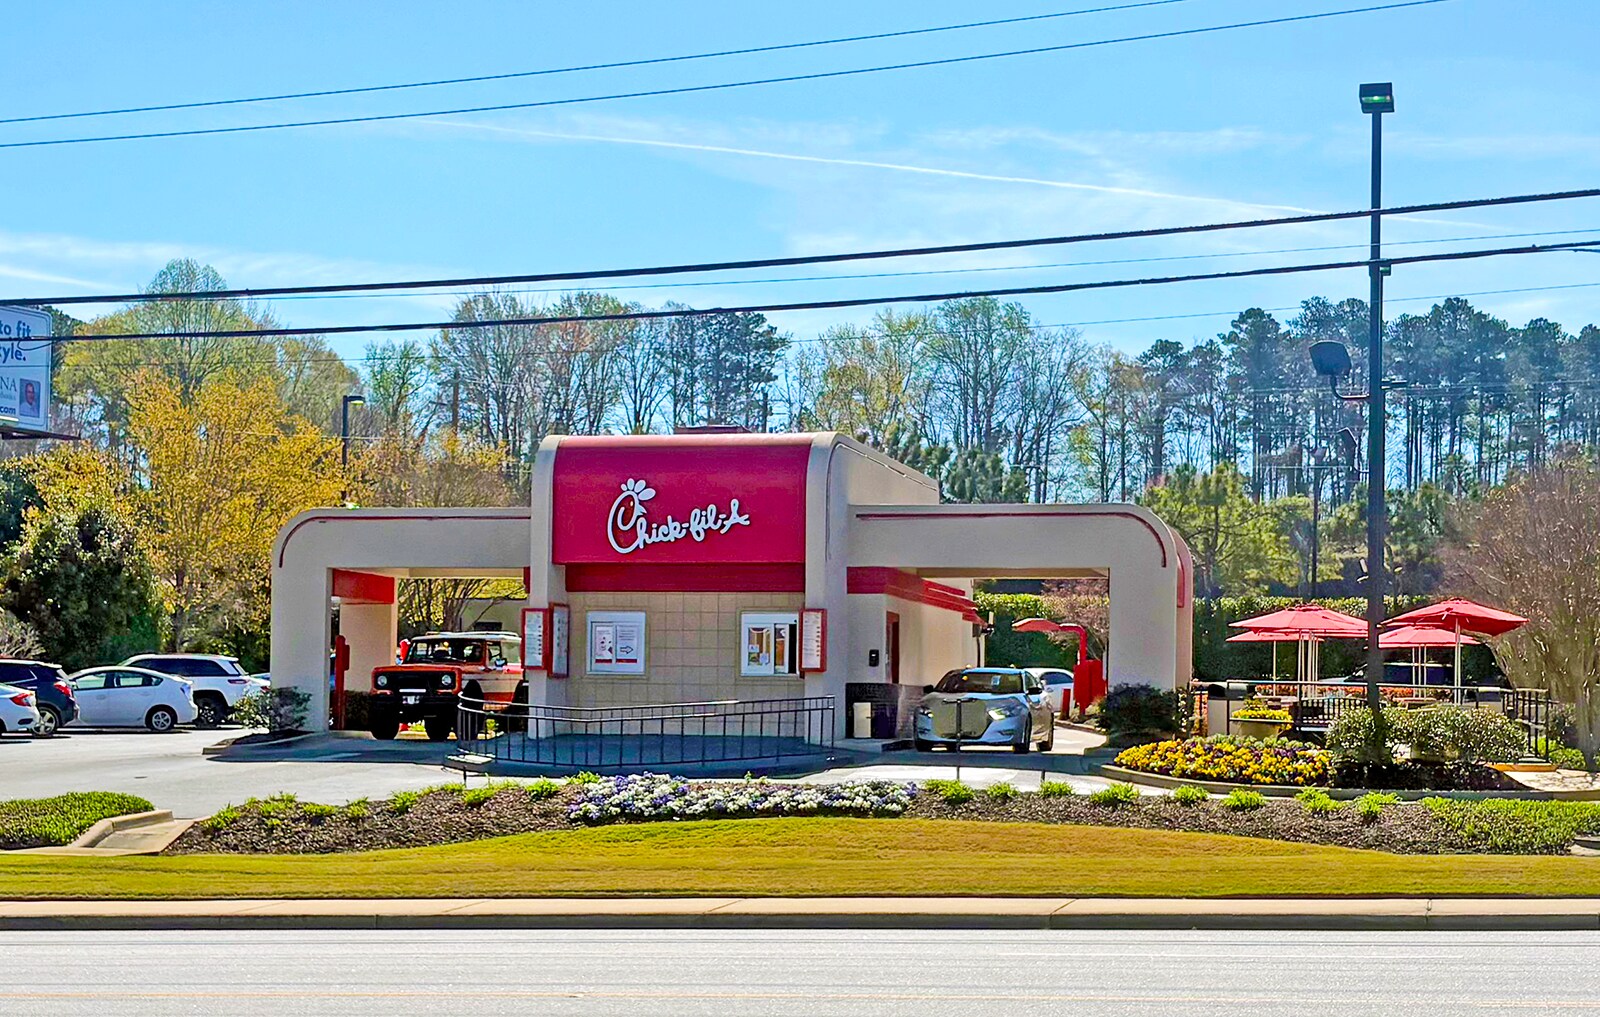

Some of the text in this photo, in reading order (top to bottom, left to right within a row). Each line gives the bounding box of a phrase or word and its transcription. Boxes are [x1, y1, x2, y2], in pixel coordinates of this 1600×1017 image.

[16, 320, 31, 337] fit
[0, 342, 26, 364] yle.
[607, 482, 750, 554] Chick-fil-A
